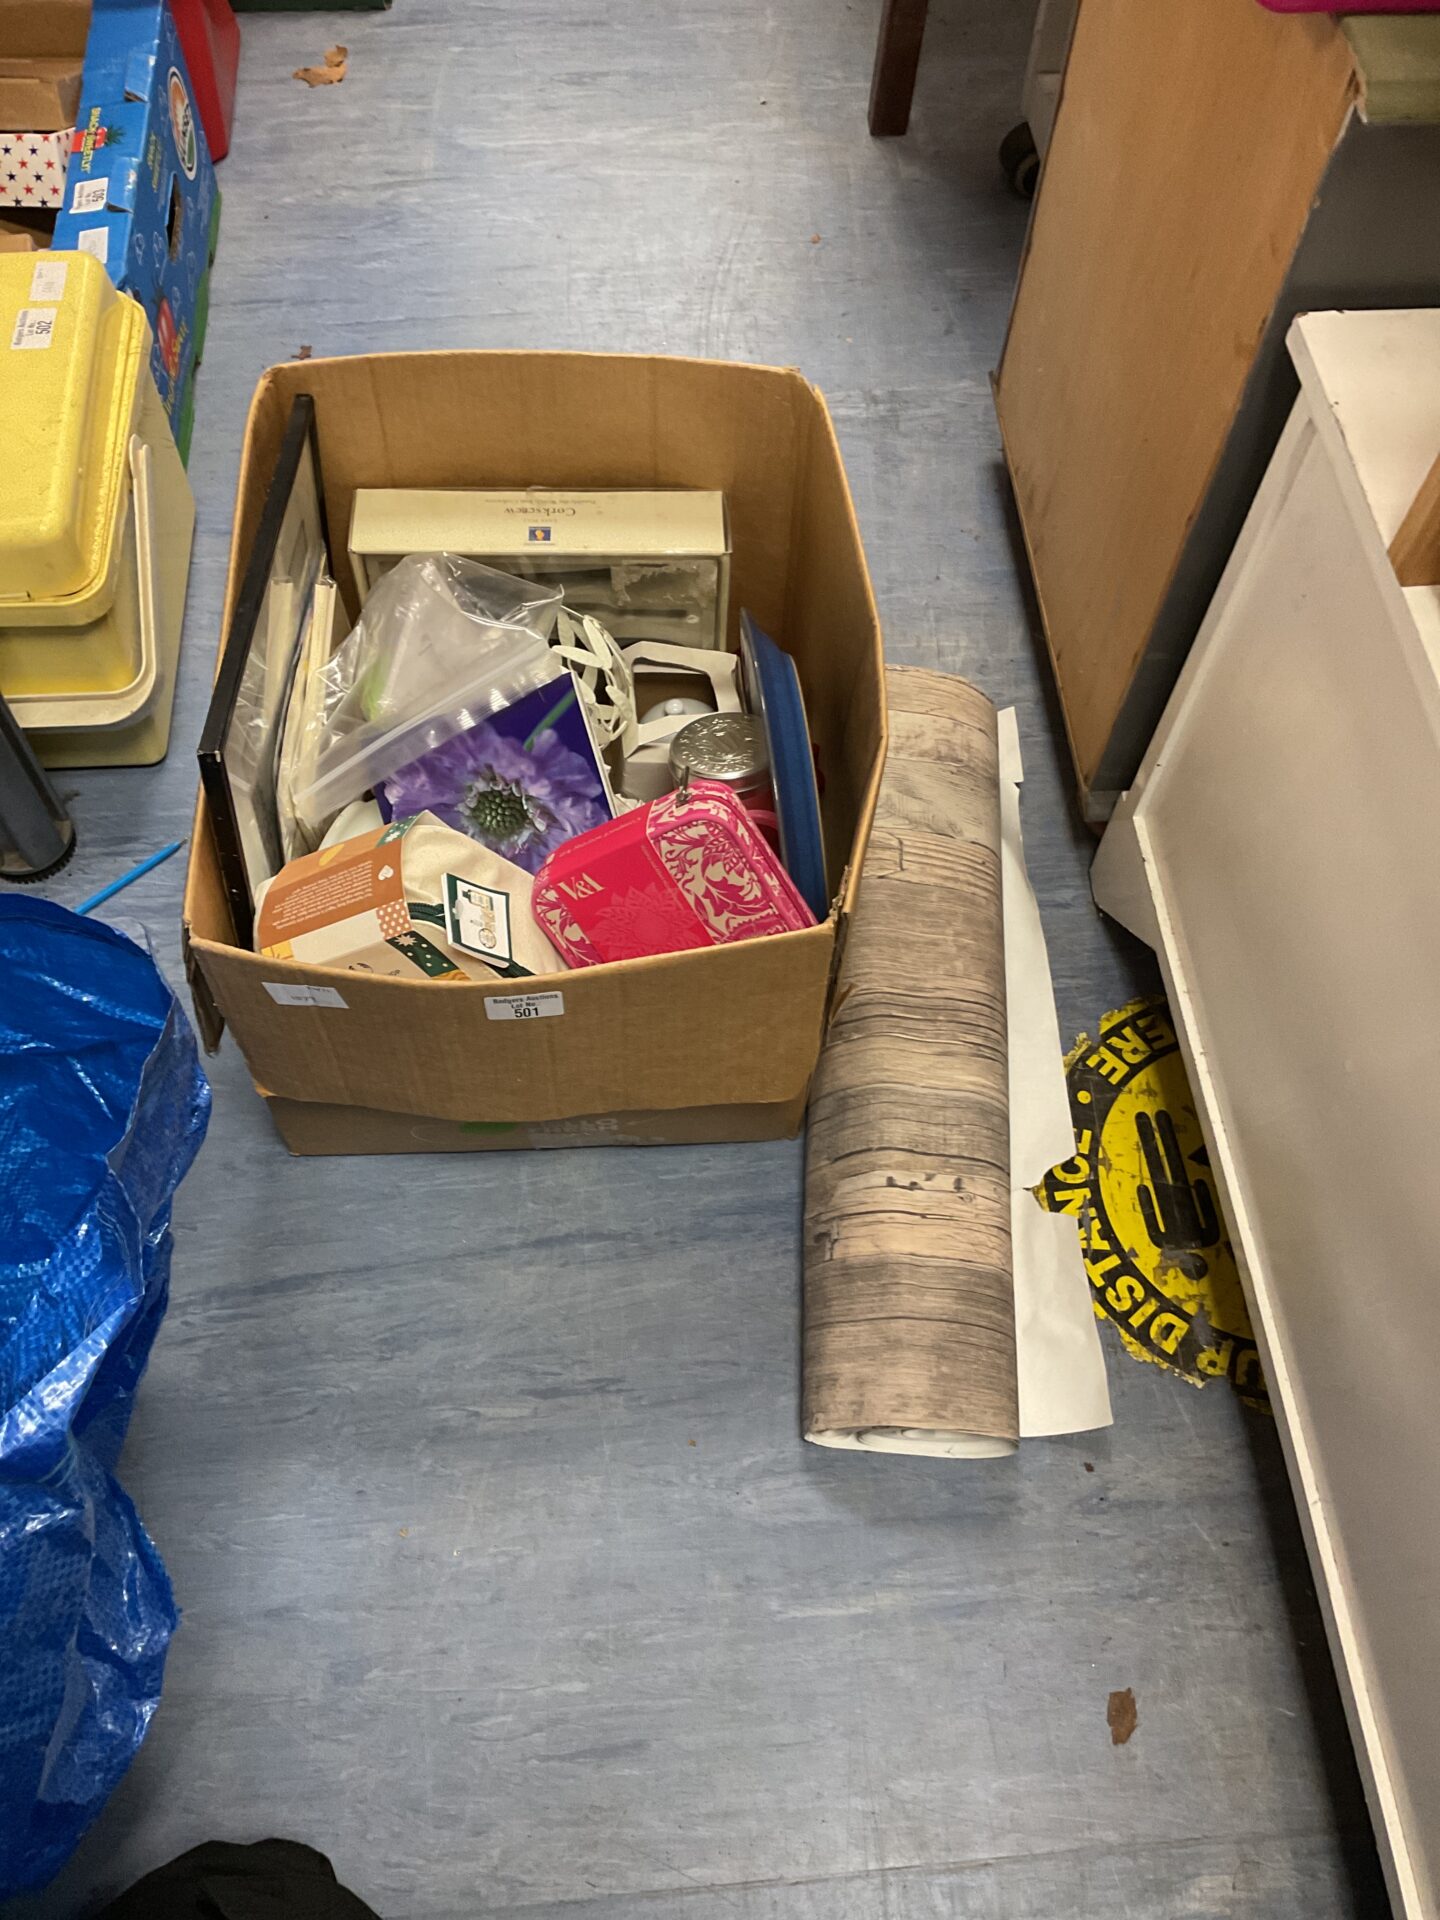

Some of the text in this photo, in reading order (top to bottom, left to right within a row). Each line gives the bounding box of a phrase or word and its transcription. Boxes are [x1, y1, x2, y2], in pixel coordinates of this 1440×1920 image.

[35, 320, 52, 335] 502
[504, 507, 576, 517] Corkscrew
[557, 872, 605, 901] V&A
[514, 1007, 539, 1018] 501
[1085, 1014, 1176, 1085] ERE
[1196, 1339, 1267, 1391] UR
